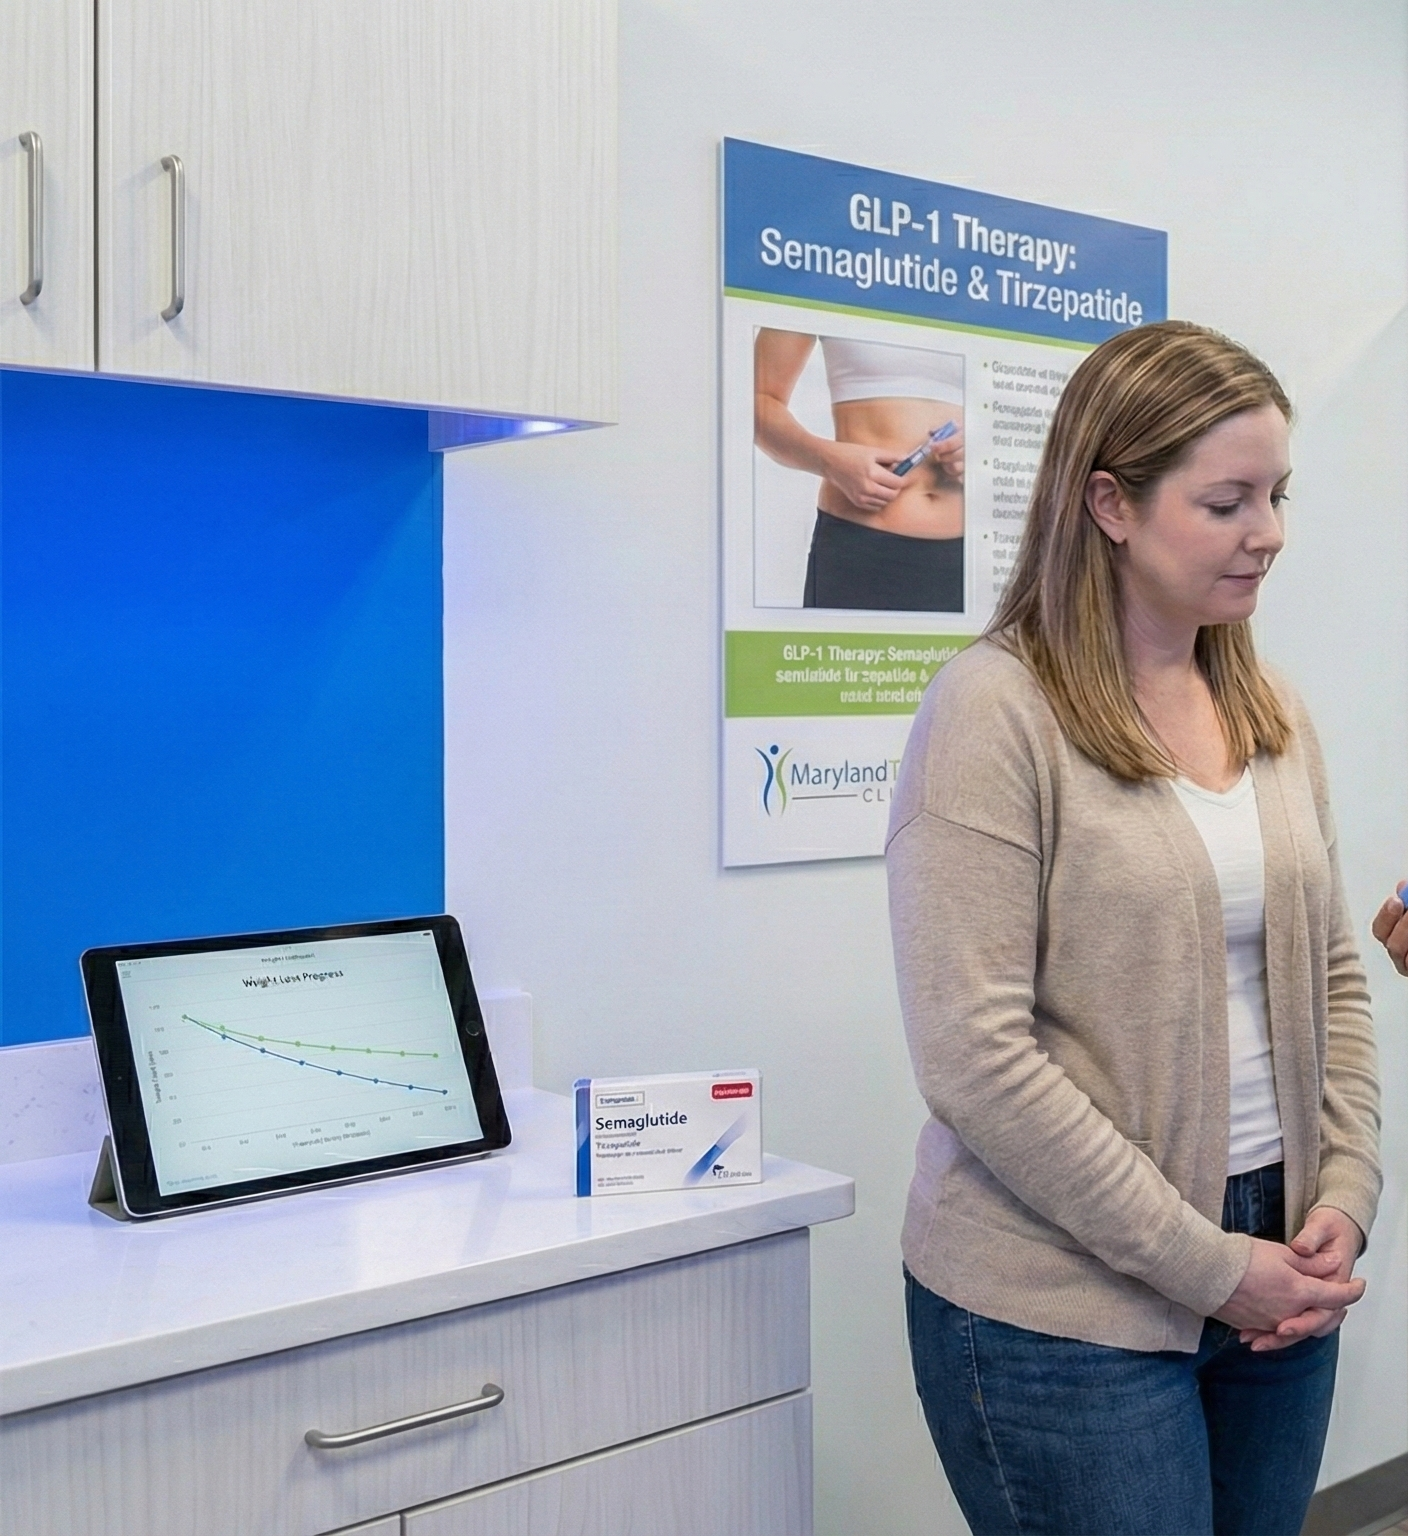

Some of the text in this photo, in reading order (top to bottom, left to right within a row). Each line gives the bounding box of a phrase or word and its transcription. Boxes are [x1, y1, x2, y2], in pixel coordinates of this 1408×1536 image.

[849, 193, 1077, 275] GLP-1 Therapy:
[760, 227, 1143, 325] Semaglutide & Tirzepatide
[783, 645, 958, 665] GLP-1 Therapy: Semaglutid
[791, 759, 900, 791] MarylandT
[862, 787, 893, 803] CLI
[595, 1111, 688, 1131] Semaglutide
